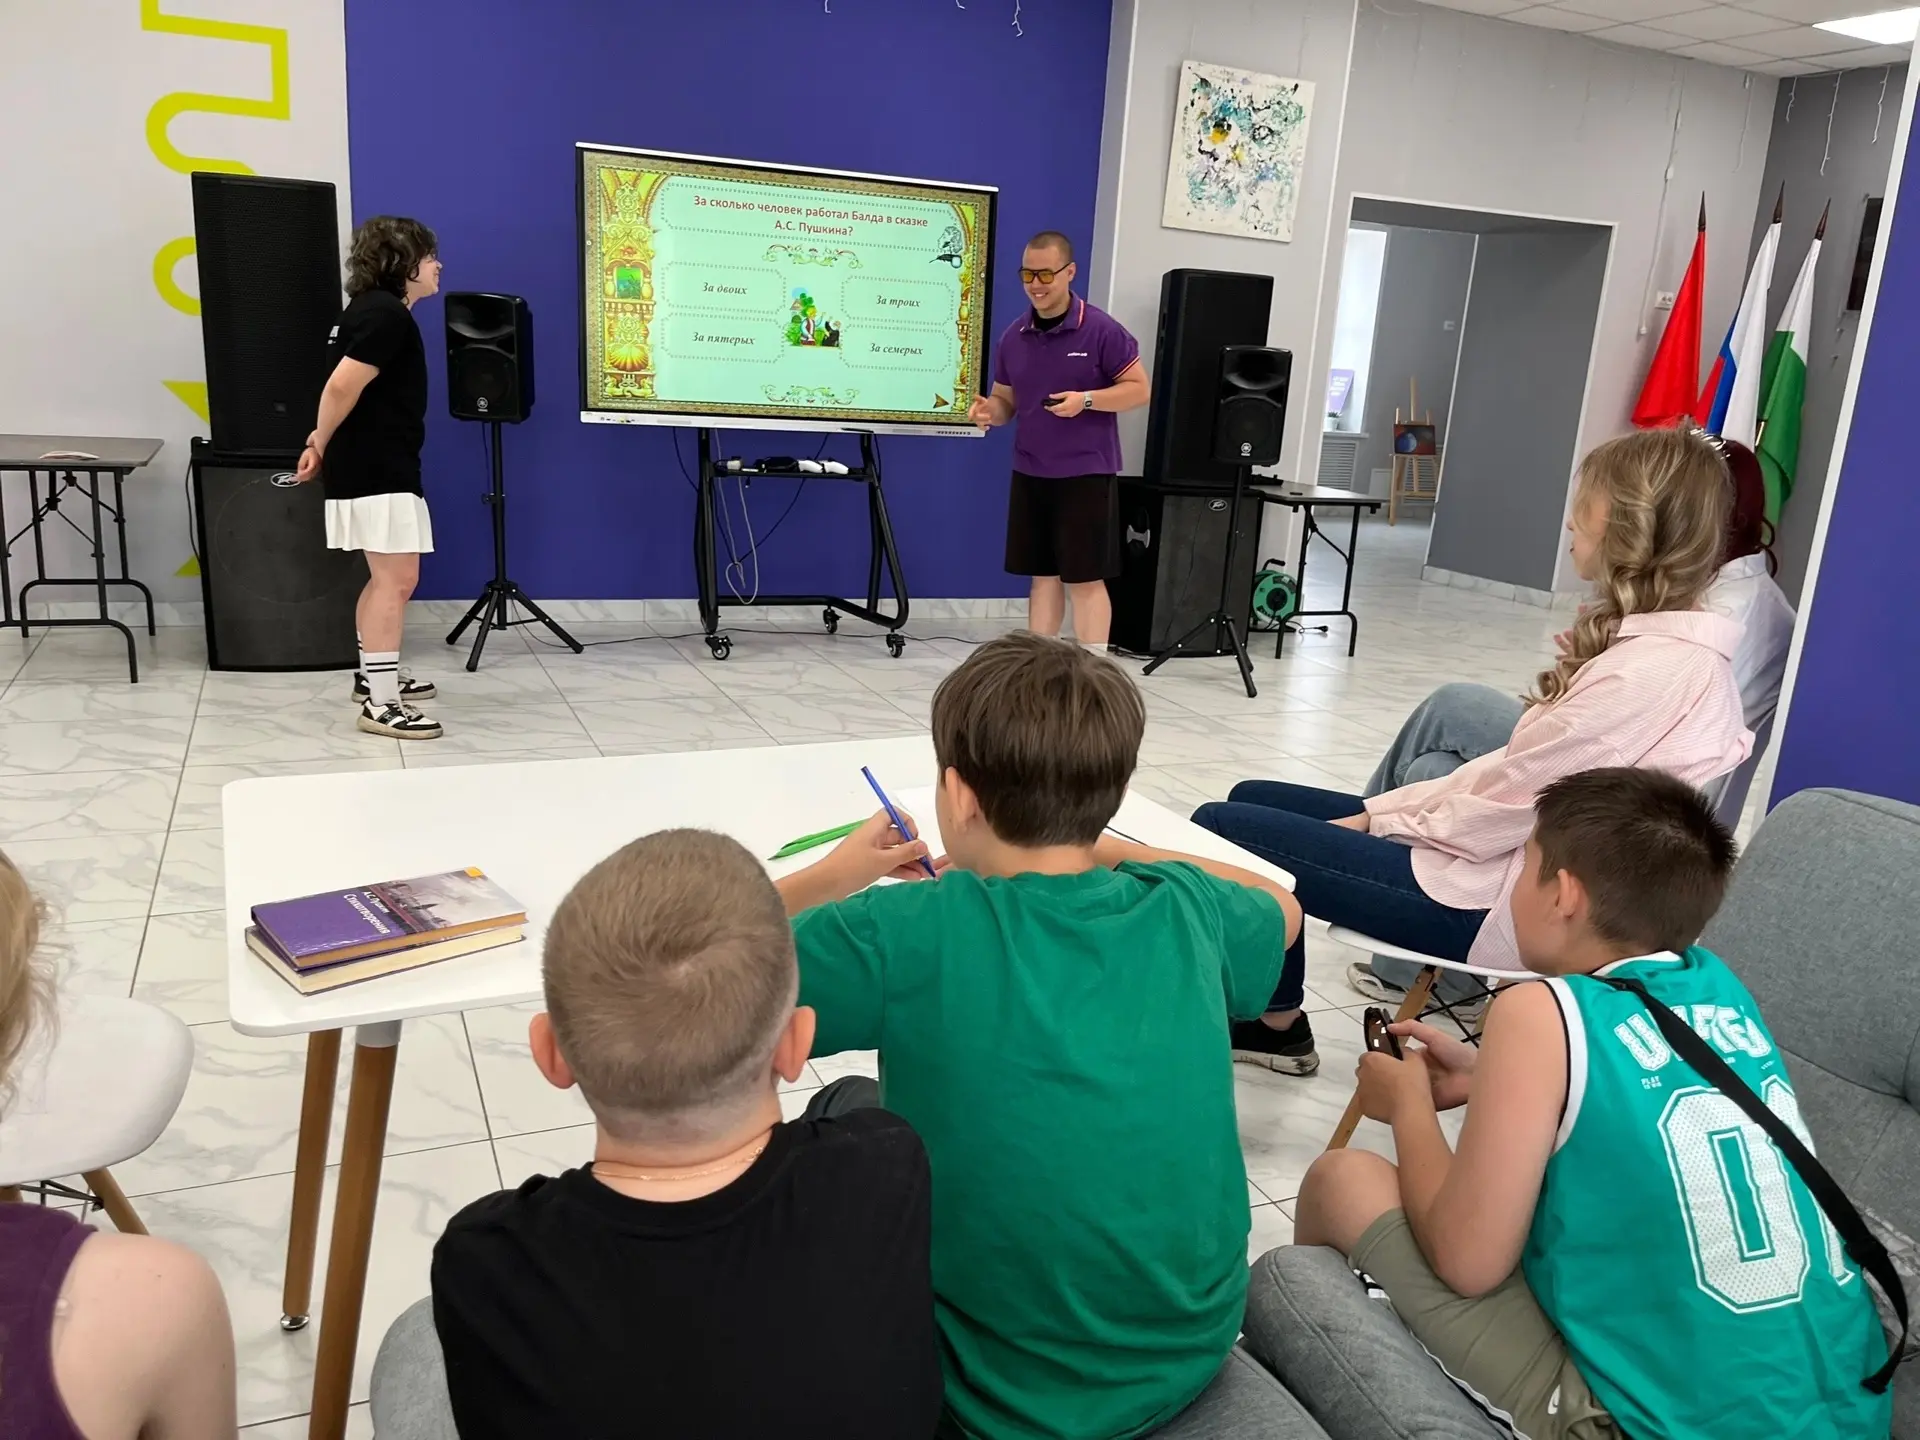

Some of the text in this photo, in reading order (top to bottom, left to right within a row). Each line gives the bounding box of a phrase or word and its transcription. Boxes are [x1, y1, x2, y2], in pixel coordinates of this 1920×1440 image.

[694, 195, 707, 206] За
[710, 199, 755, 210] сколько
[758, 204, 803, 215] человек
[806, 207, 849, 220] работал
[852, 211, 884, 224] Балда
[895, 217, 928, 227] сказке
[775, 220, 854, 237] А.С. Пушкина?
[702, 281, 748, 295] За двоих
[876, 295, 921, 308] За троих
[693, 331, 756, 346] За пятерых
[870, 342, 924, 356] За семерых
